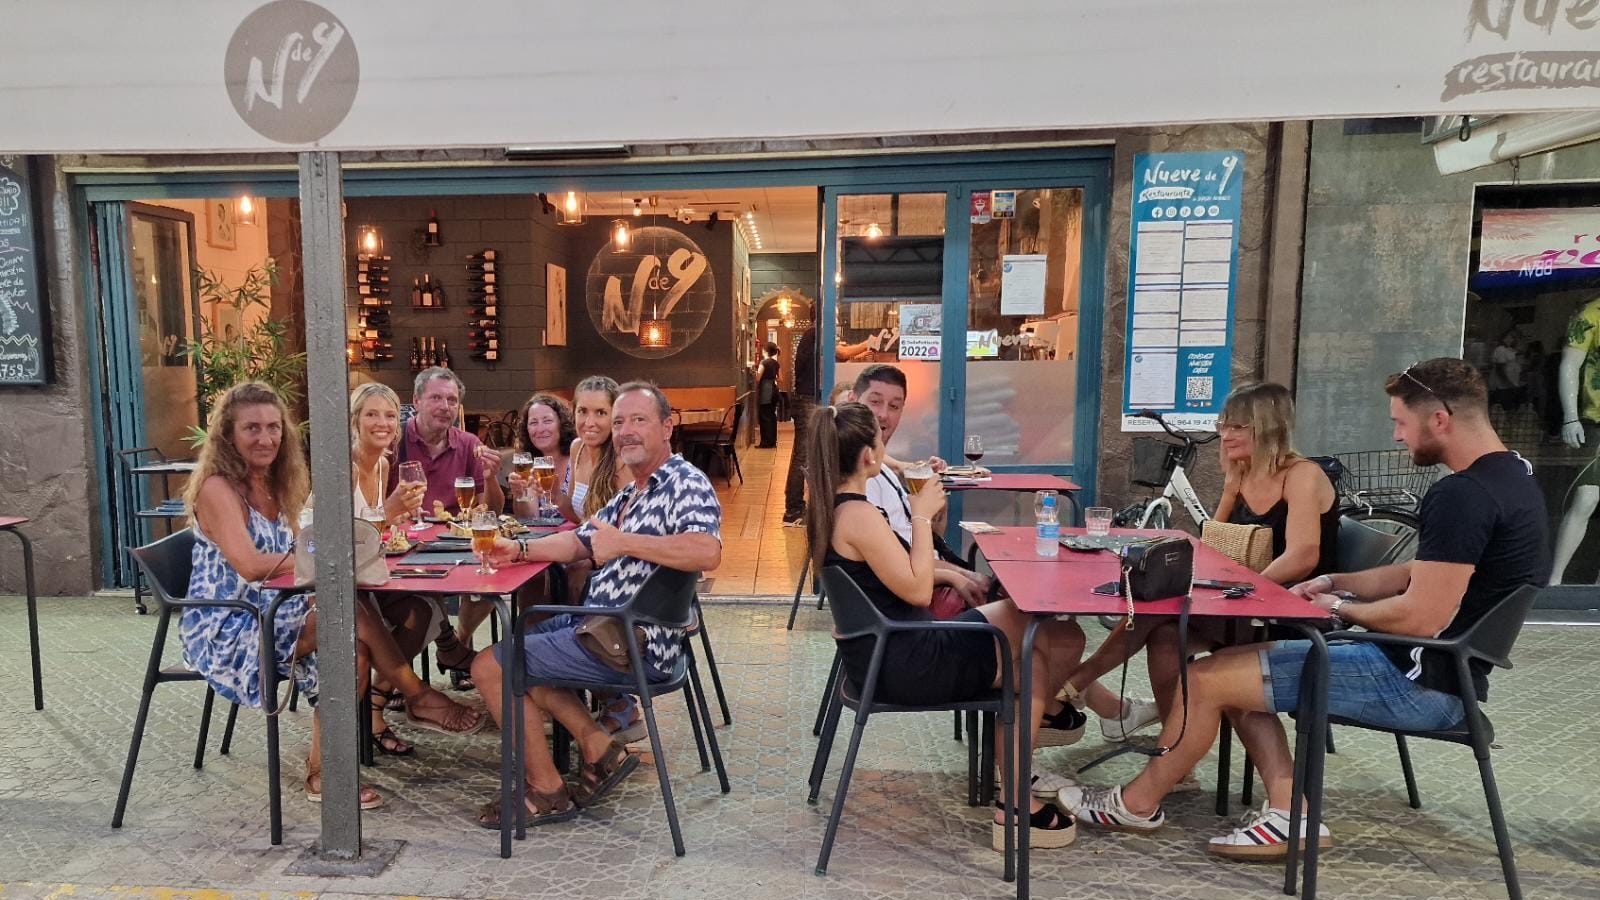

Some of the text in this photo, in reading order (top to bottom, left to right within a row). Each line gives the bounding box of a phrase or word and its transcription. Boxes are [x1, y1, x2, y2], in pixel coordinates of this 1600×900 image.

[291, 41, 312, 62] de
[1458, 51, 1600, 90] restaura
[1144, 161, 1201, 185] Nueve
[1204, 171, 1217, 181] de
[648, 268, 671, 290] de
[901, 346, 927, 356] 2022
[0, 364, 24, 378] 759
[1127, 419, 1162, 427] RESERV
